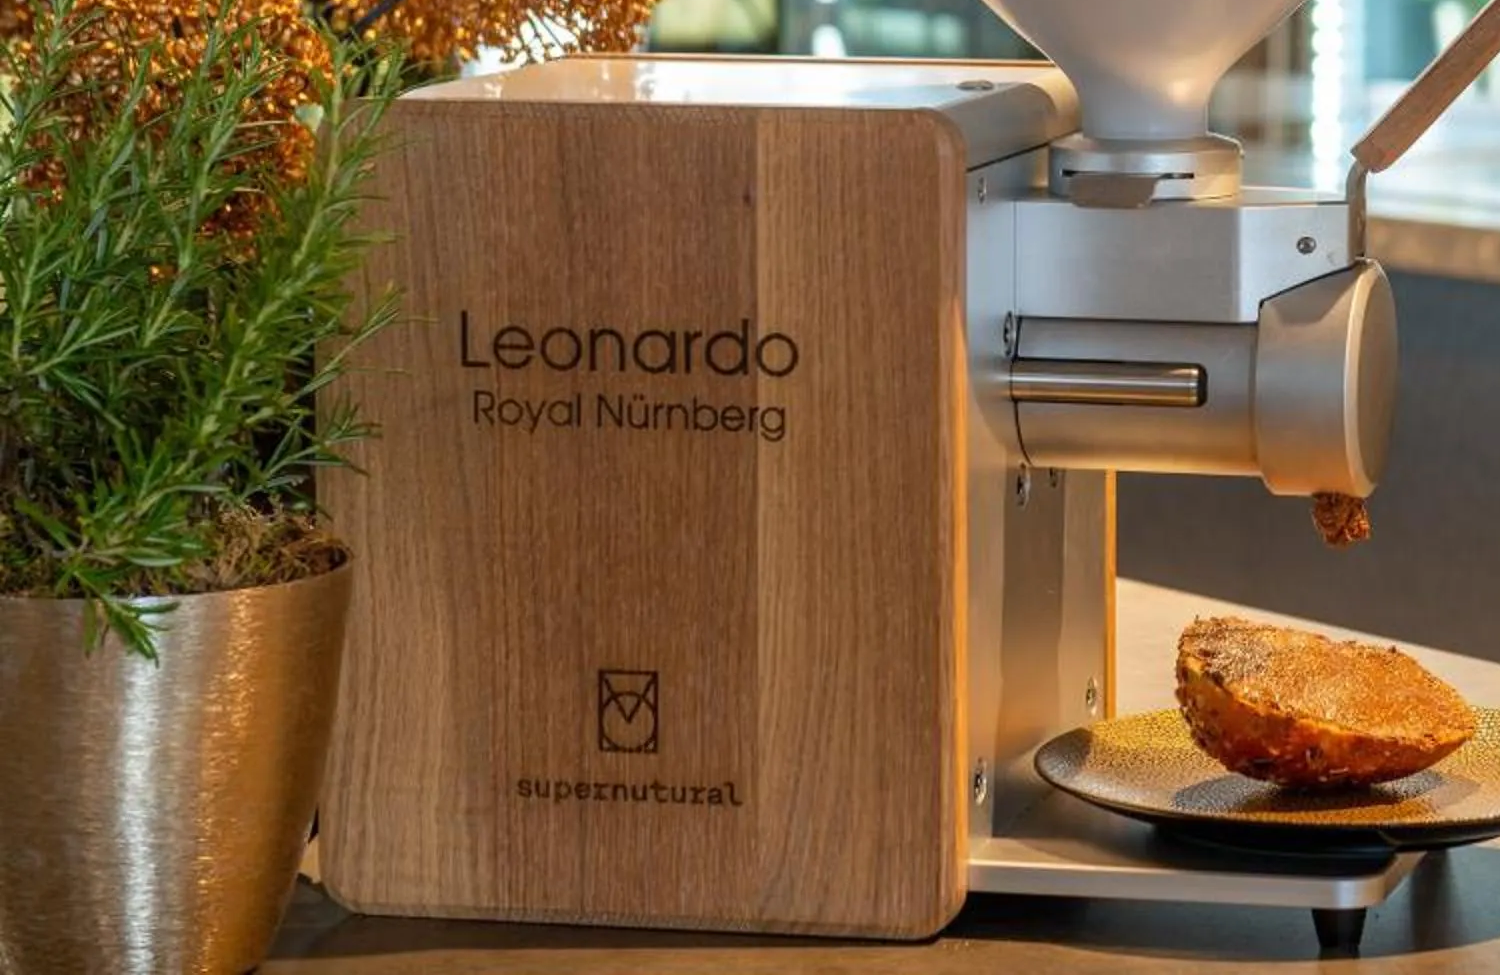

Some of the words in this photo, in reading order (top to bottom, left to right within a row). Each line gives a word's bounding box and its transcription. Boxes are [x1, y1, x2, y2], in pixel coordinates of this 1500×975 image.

[460, 310, 799, 377] Leonardo
[473, 390, 582, 435] Royal
[597, 395, 786, 442] Nürnberg
[516, 778, 743, 806] supernutural
